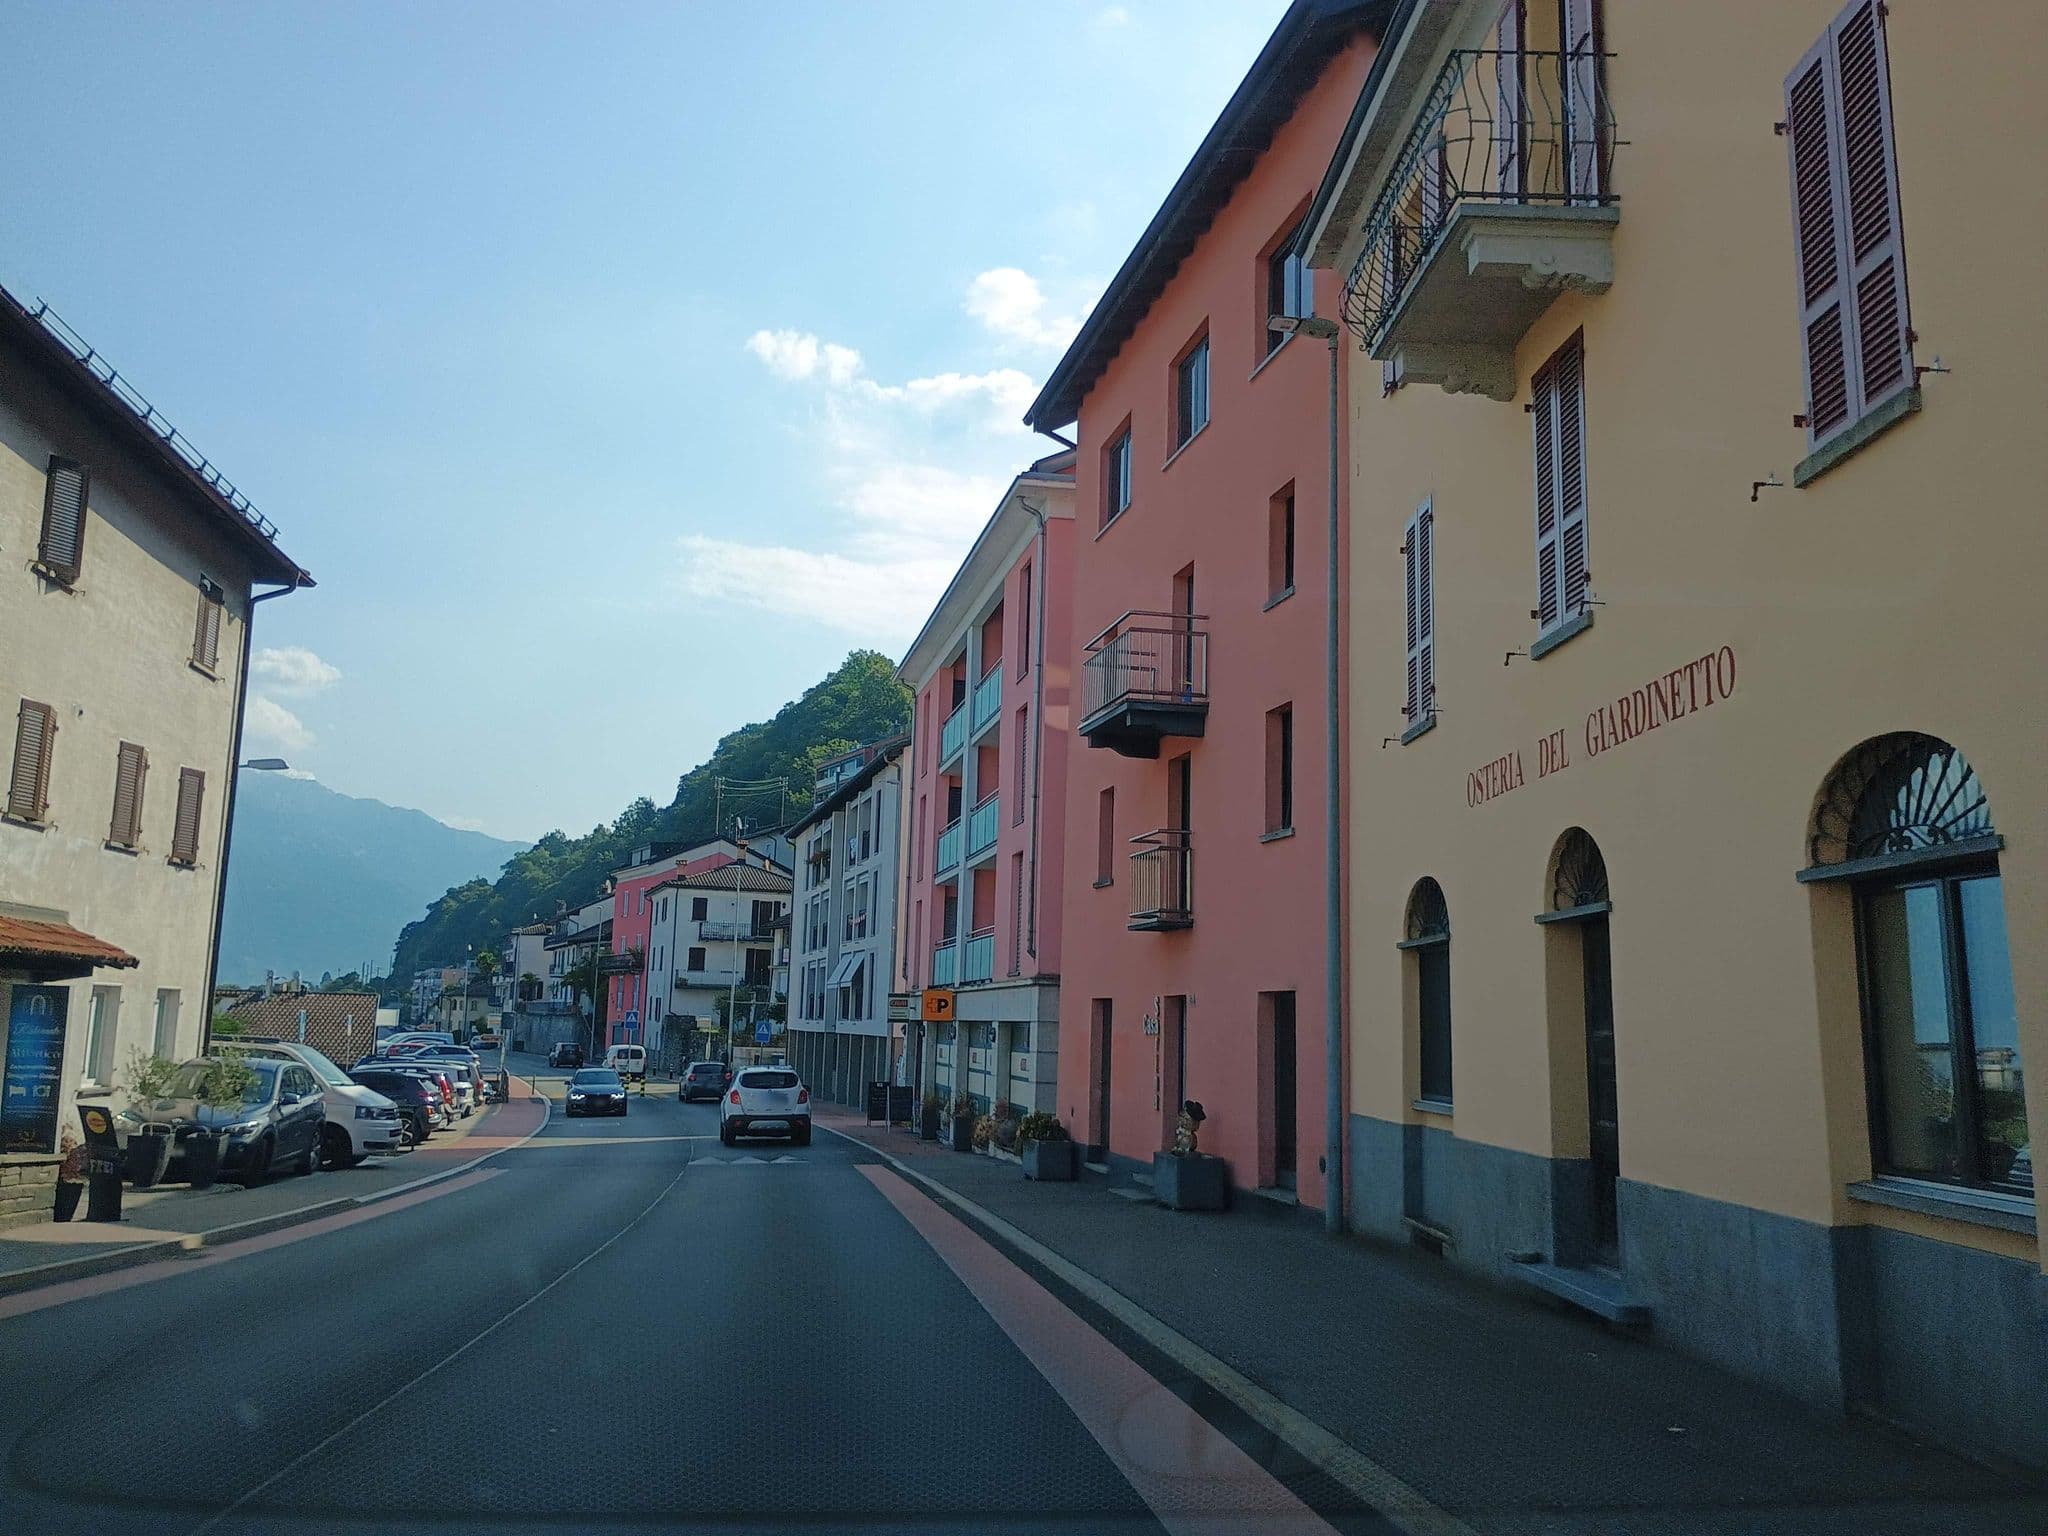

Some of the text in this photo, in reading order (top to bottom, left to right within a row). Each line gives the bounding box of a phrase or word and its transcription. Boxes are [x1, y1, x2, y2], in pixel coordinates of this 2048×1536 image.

[1466, 645, 1736, 808] OSTERIA DEL GIARDINETTO
